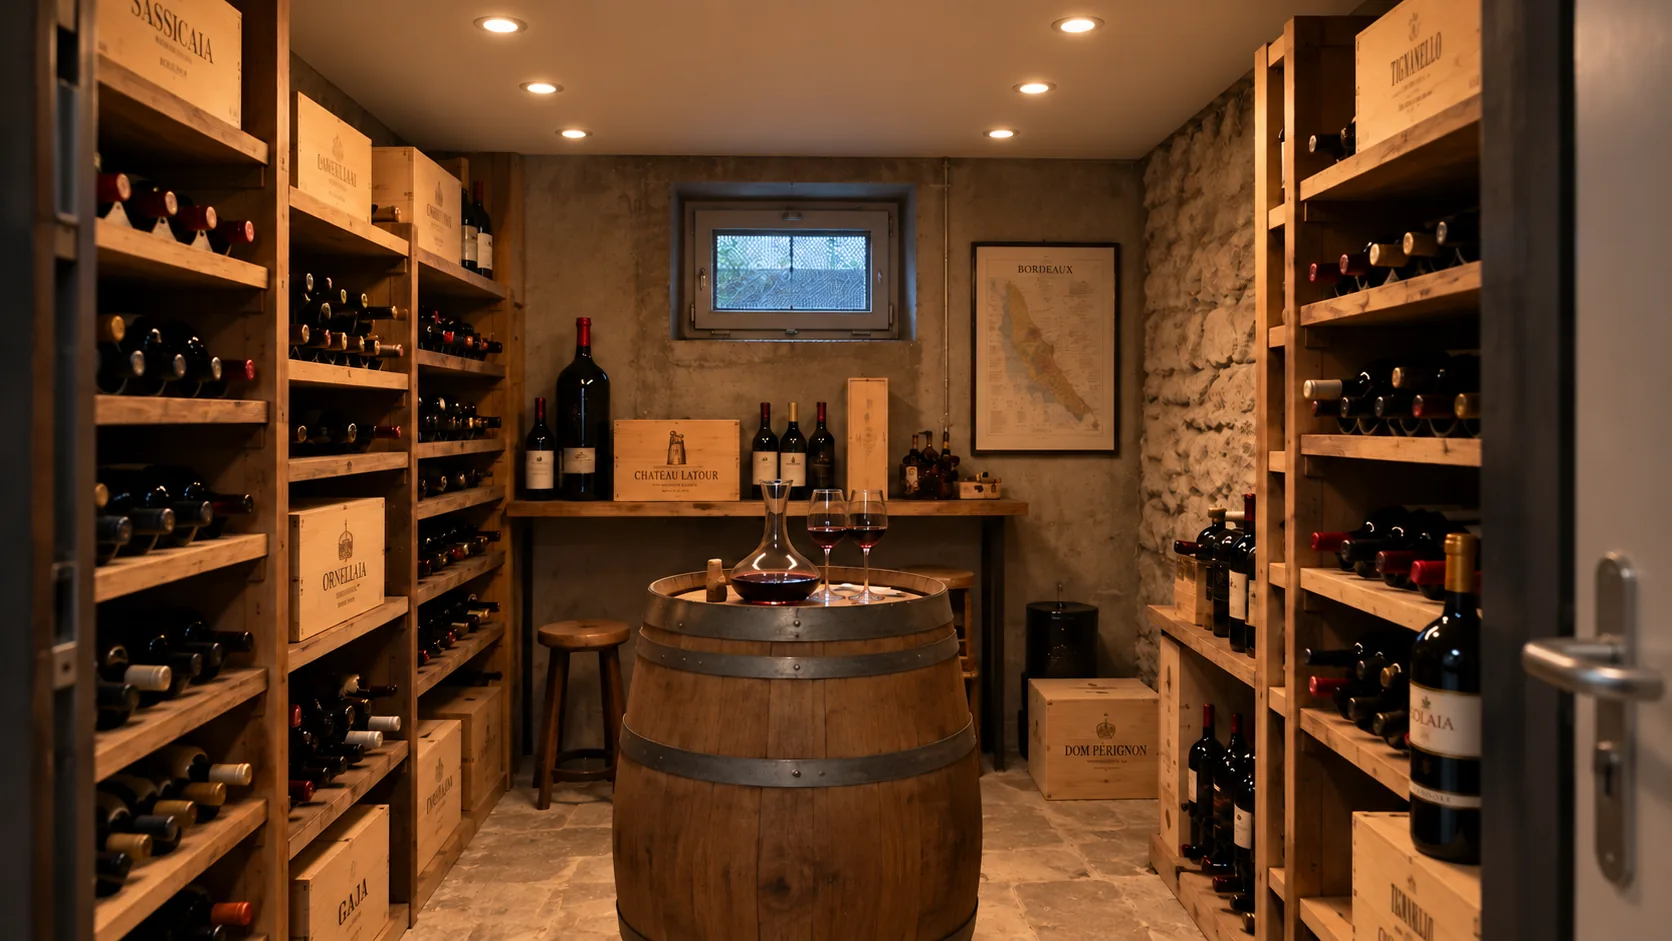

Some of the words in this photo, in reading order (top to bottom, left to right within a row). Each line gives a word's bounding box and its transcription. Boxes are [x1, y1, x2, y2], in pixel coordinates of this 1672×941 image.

[131, 0, 214, 64] SASSICAIA
[1391, 31, 1442, 87] TIGNANELLO
[1018, 265, 1073, 274] BORDEAUX
[634, 470, 678, 481] CHATEAU
[681, 470, 719, 481] LATOUR
[322, 562, 367, 591] ORNELLAIA
[1065, 744, 1090, 756] DOM
[1092, 741, 1147, 756] PÉRIGNON
[338, 878, 368, 926] GAJA
